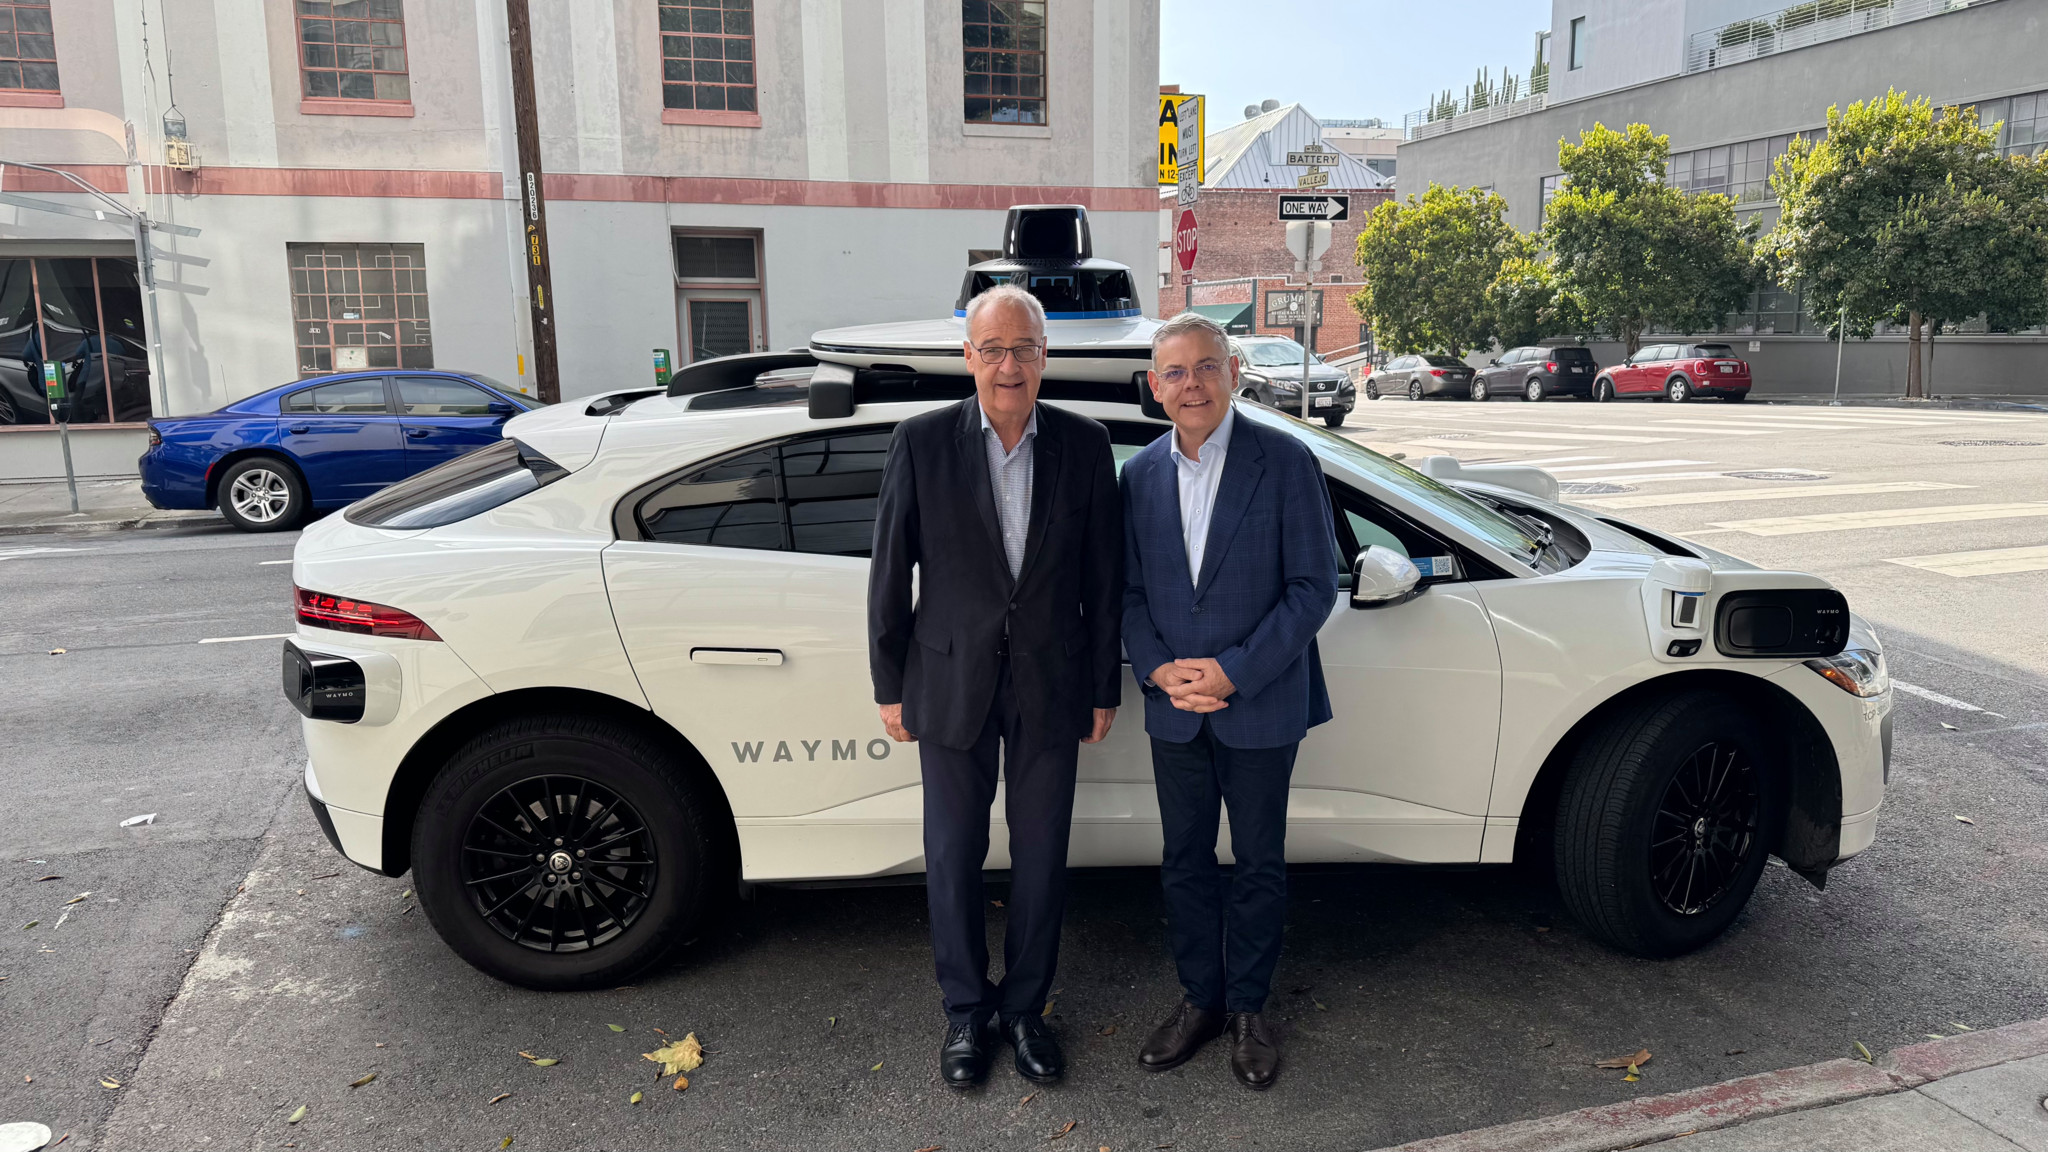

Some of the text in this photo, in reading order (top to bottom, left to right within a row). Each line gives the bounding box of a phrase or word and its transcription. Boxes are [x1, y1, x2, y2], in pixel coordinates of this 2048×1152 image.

[1182, 125, 1194, 141] MUST
[1188, 143, 1197, 156] LEFT
[1290, 155, 1337, 164] BATTERY
[1179, 168, 1197, 183] EXCEPT
[1298, 175, 1327, 187] VALLEJO
[1284, 202, 1329, 214] ONE WAY
[1177, 227, 1197, 253] STOP
[730, 738, 891, 763] WAYMO
